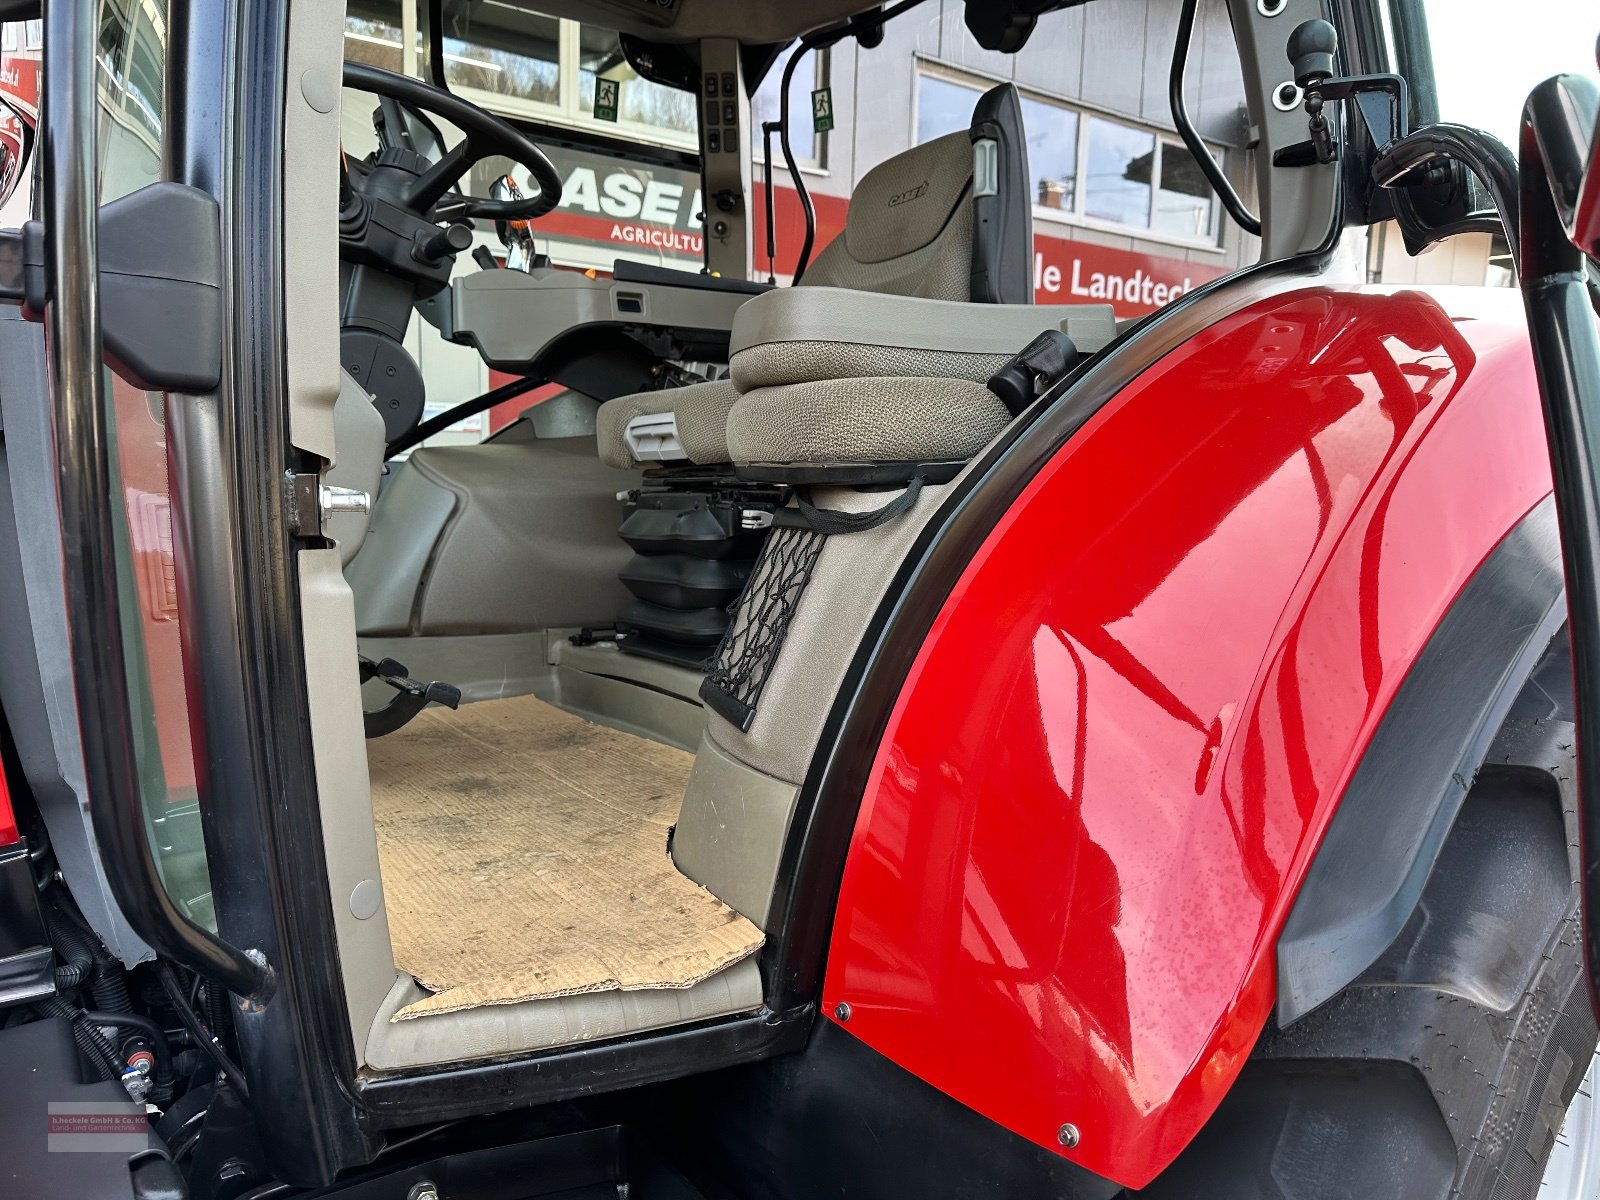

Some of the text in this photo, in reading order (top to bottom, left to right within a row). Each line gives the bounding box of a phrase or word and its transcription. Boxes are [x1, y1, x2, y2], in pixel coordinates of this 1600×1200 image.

[611, 223, 702, 252] AGRICULTU
[1034, 252, 1195, 308] le Landtech
